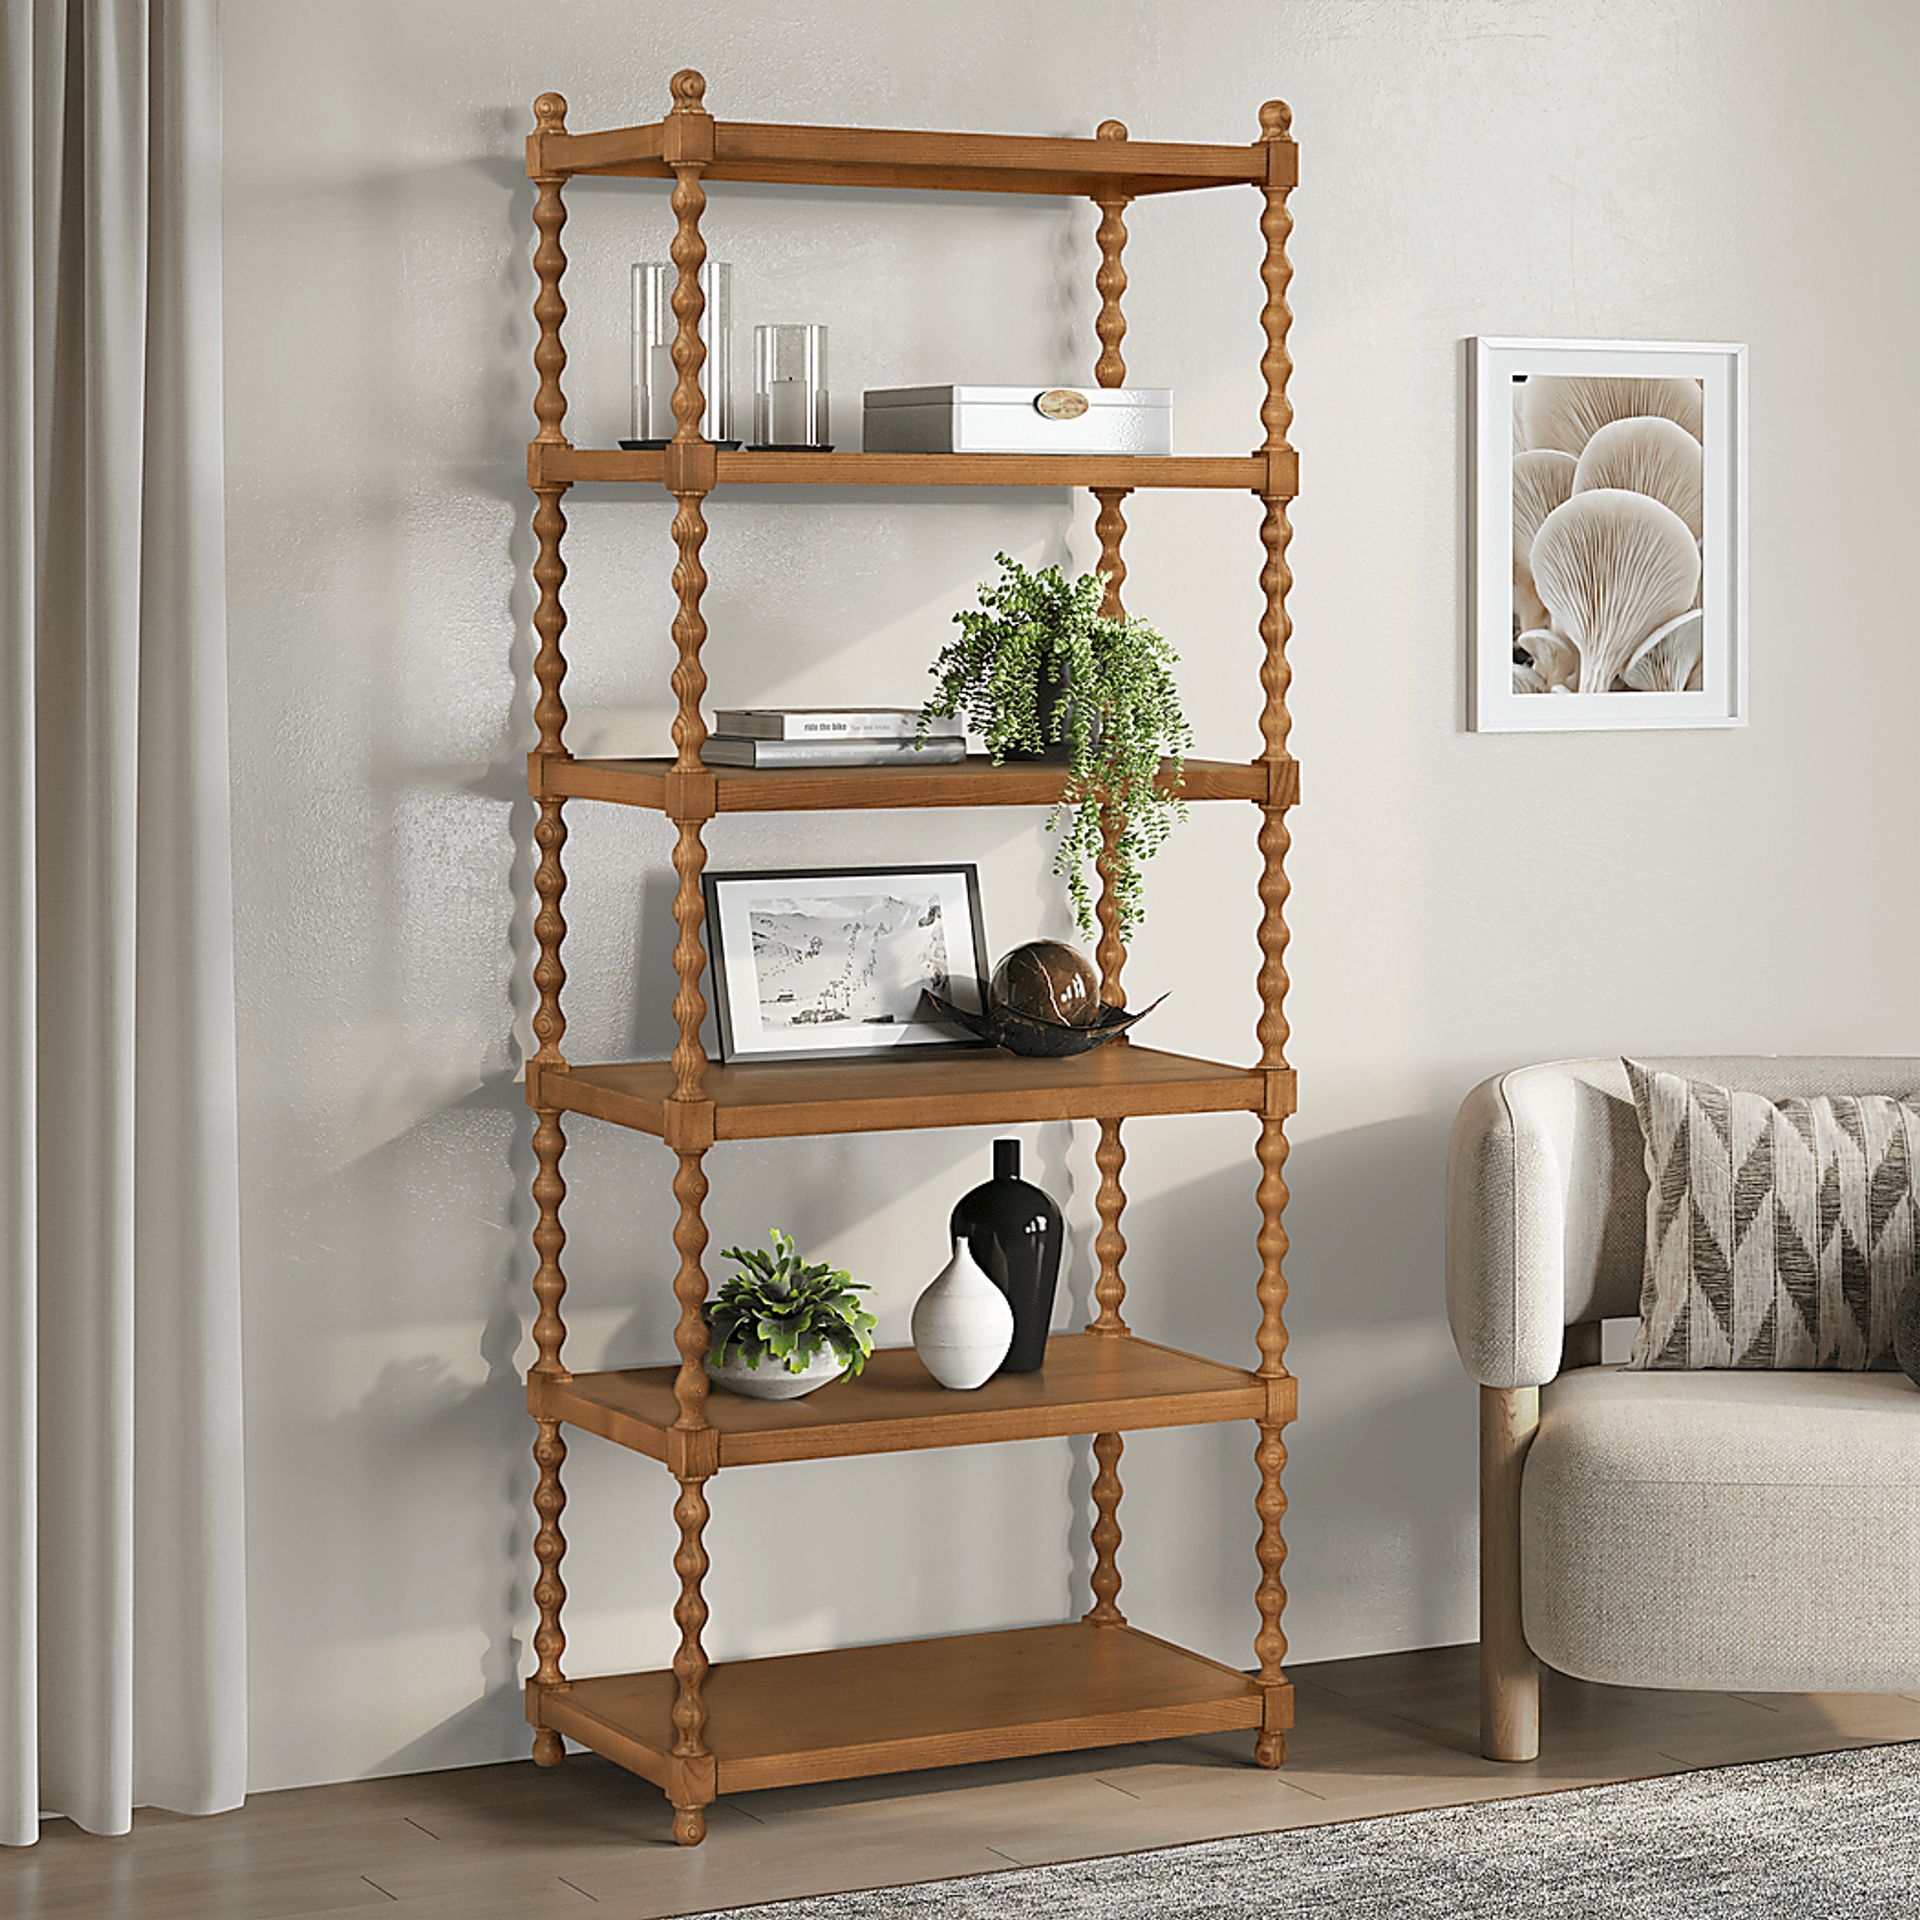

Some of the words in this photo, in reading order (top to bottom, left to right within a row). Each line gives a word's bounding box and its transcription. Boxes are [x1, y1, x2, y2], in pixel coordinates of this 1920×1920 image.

[804, 723, 818, 731] ride
[819, 722, 831, 731] the
[832, 722, 846, 731] bike
